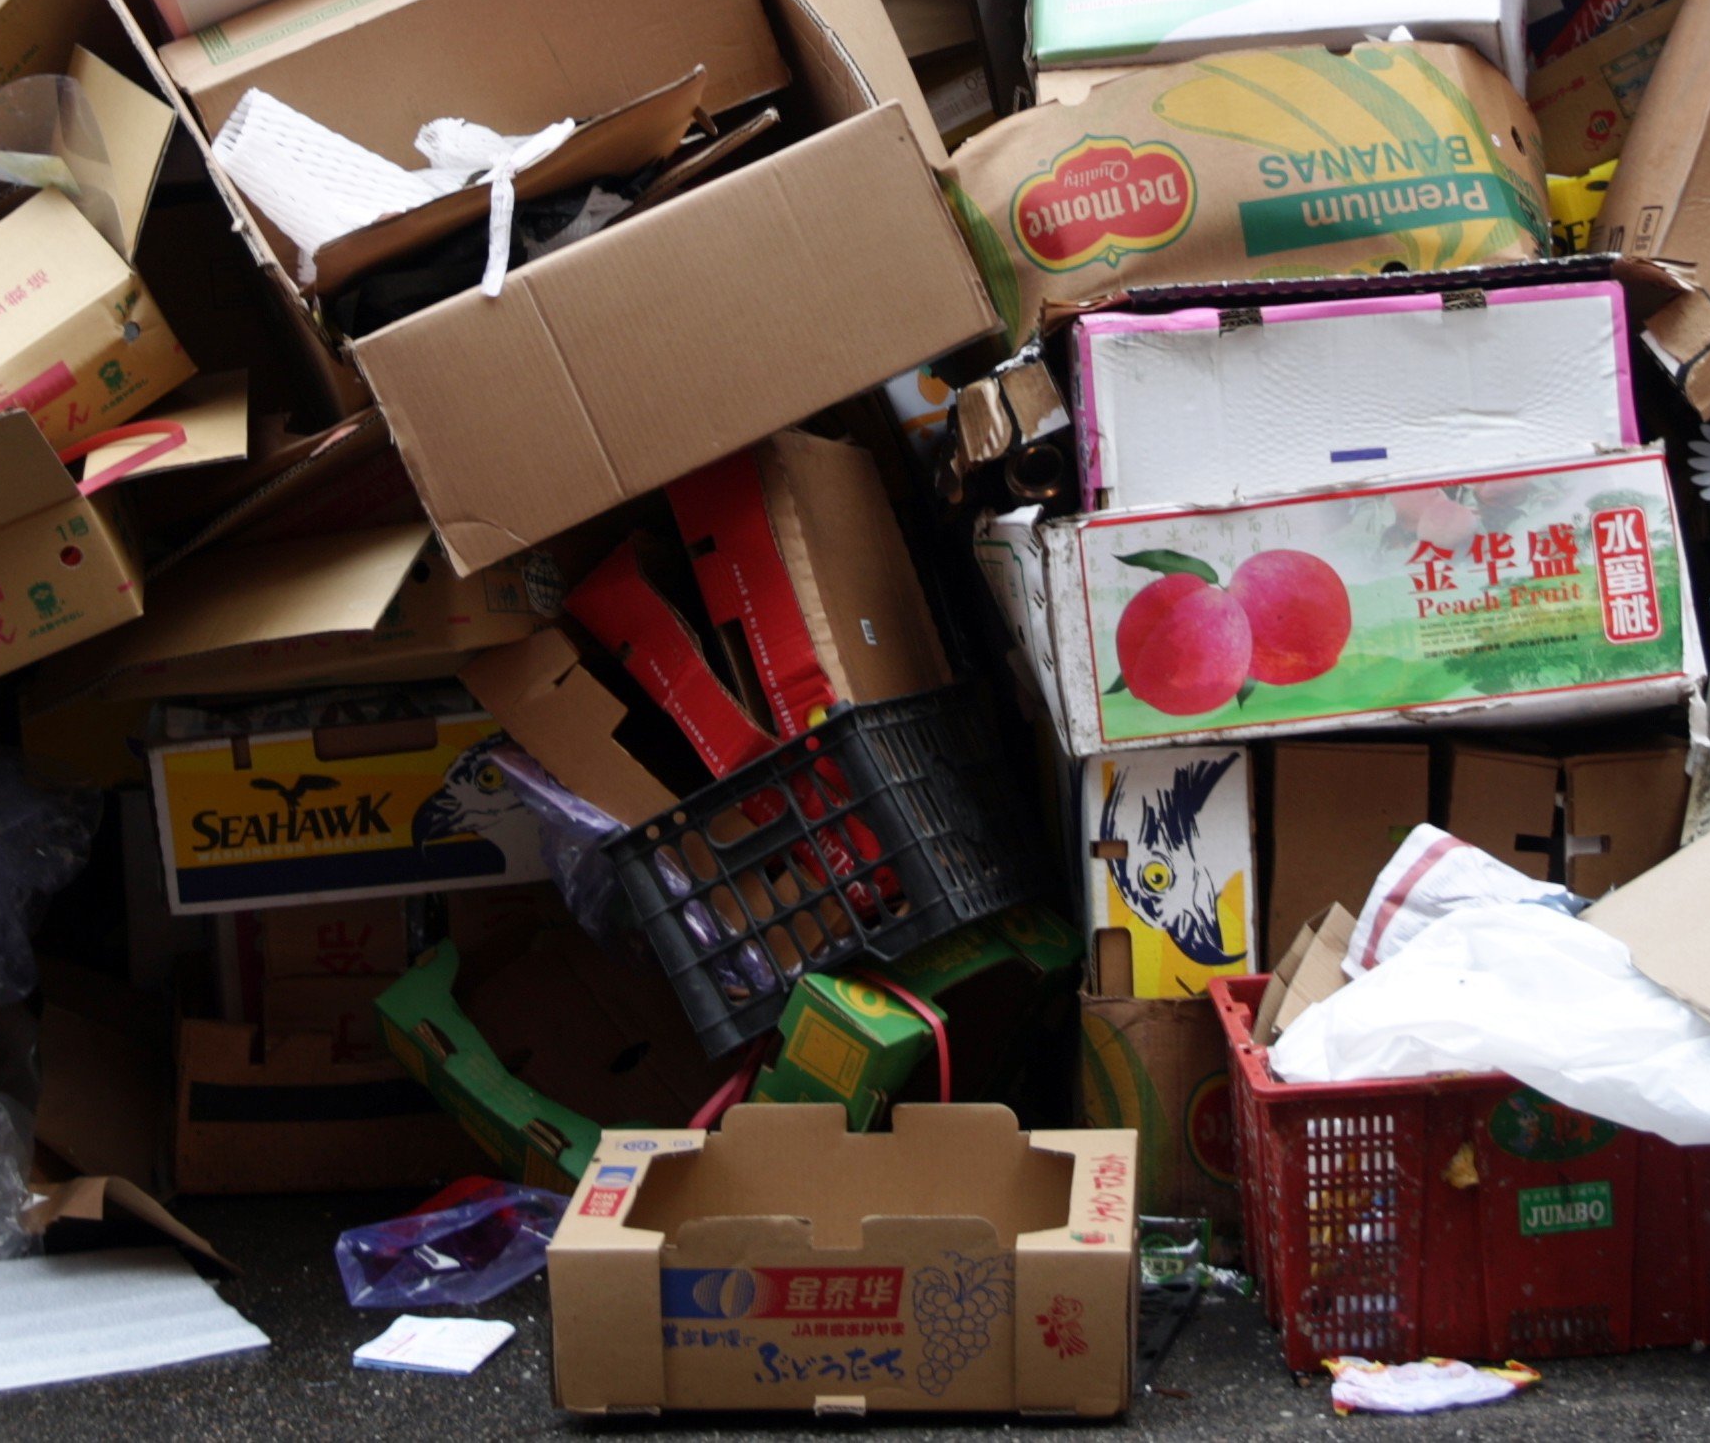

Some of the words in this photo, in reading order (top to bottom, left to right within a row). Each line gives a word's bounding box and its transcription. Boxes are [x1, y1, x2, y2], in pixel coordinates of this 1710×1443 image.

[1062, 159, 1131, 187] Quality
[1259, 135, 1475, 190] BANANAS
[1136, 168, 1181, 207] Del
[1301, 179, 1489, 231] Premium
[1023, 183, 1133, 242] Monte
[1405, 522, 1582, 595] 金华盛
[1414, 589, 1501, 619] Peach
[1508, 581, 1583, 608] Fruit
[191, 790, 392, 853] SEAHAWK
[1526, 1200, 1605, 1228] JUMBO
[784, 1275, 896, 1313] 金泰华
